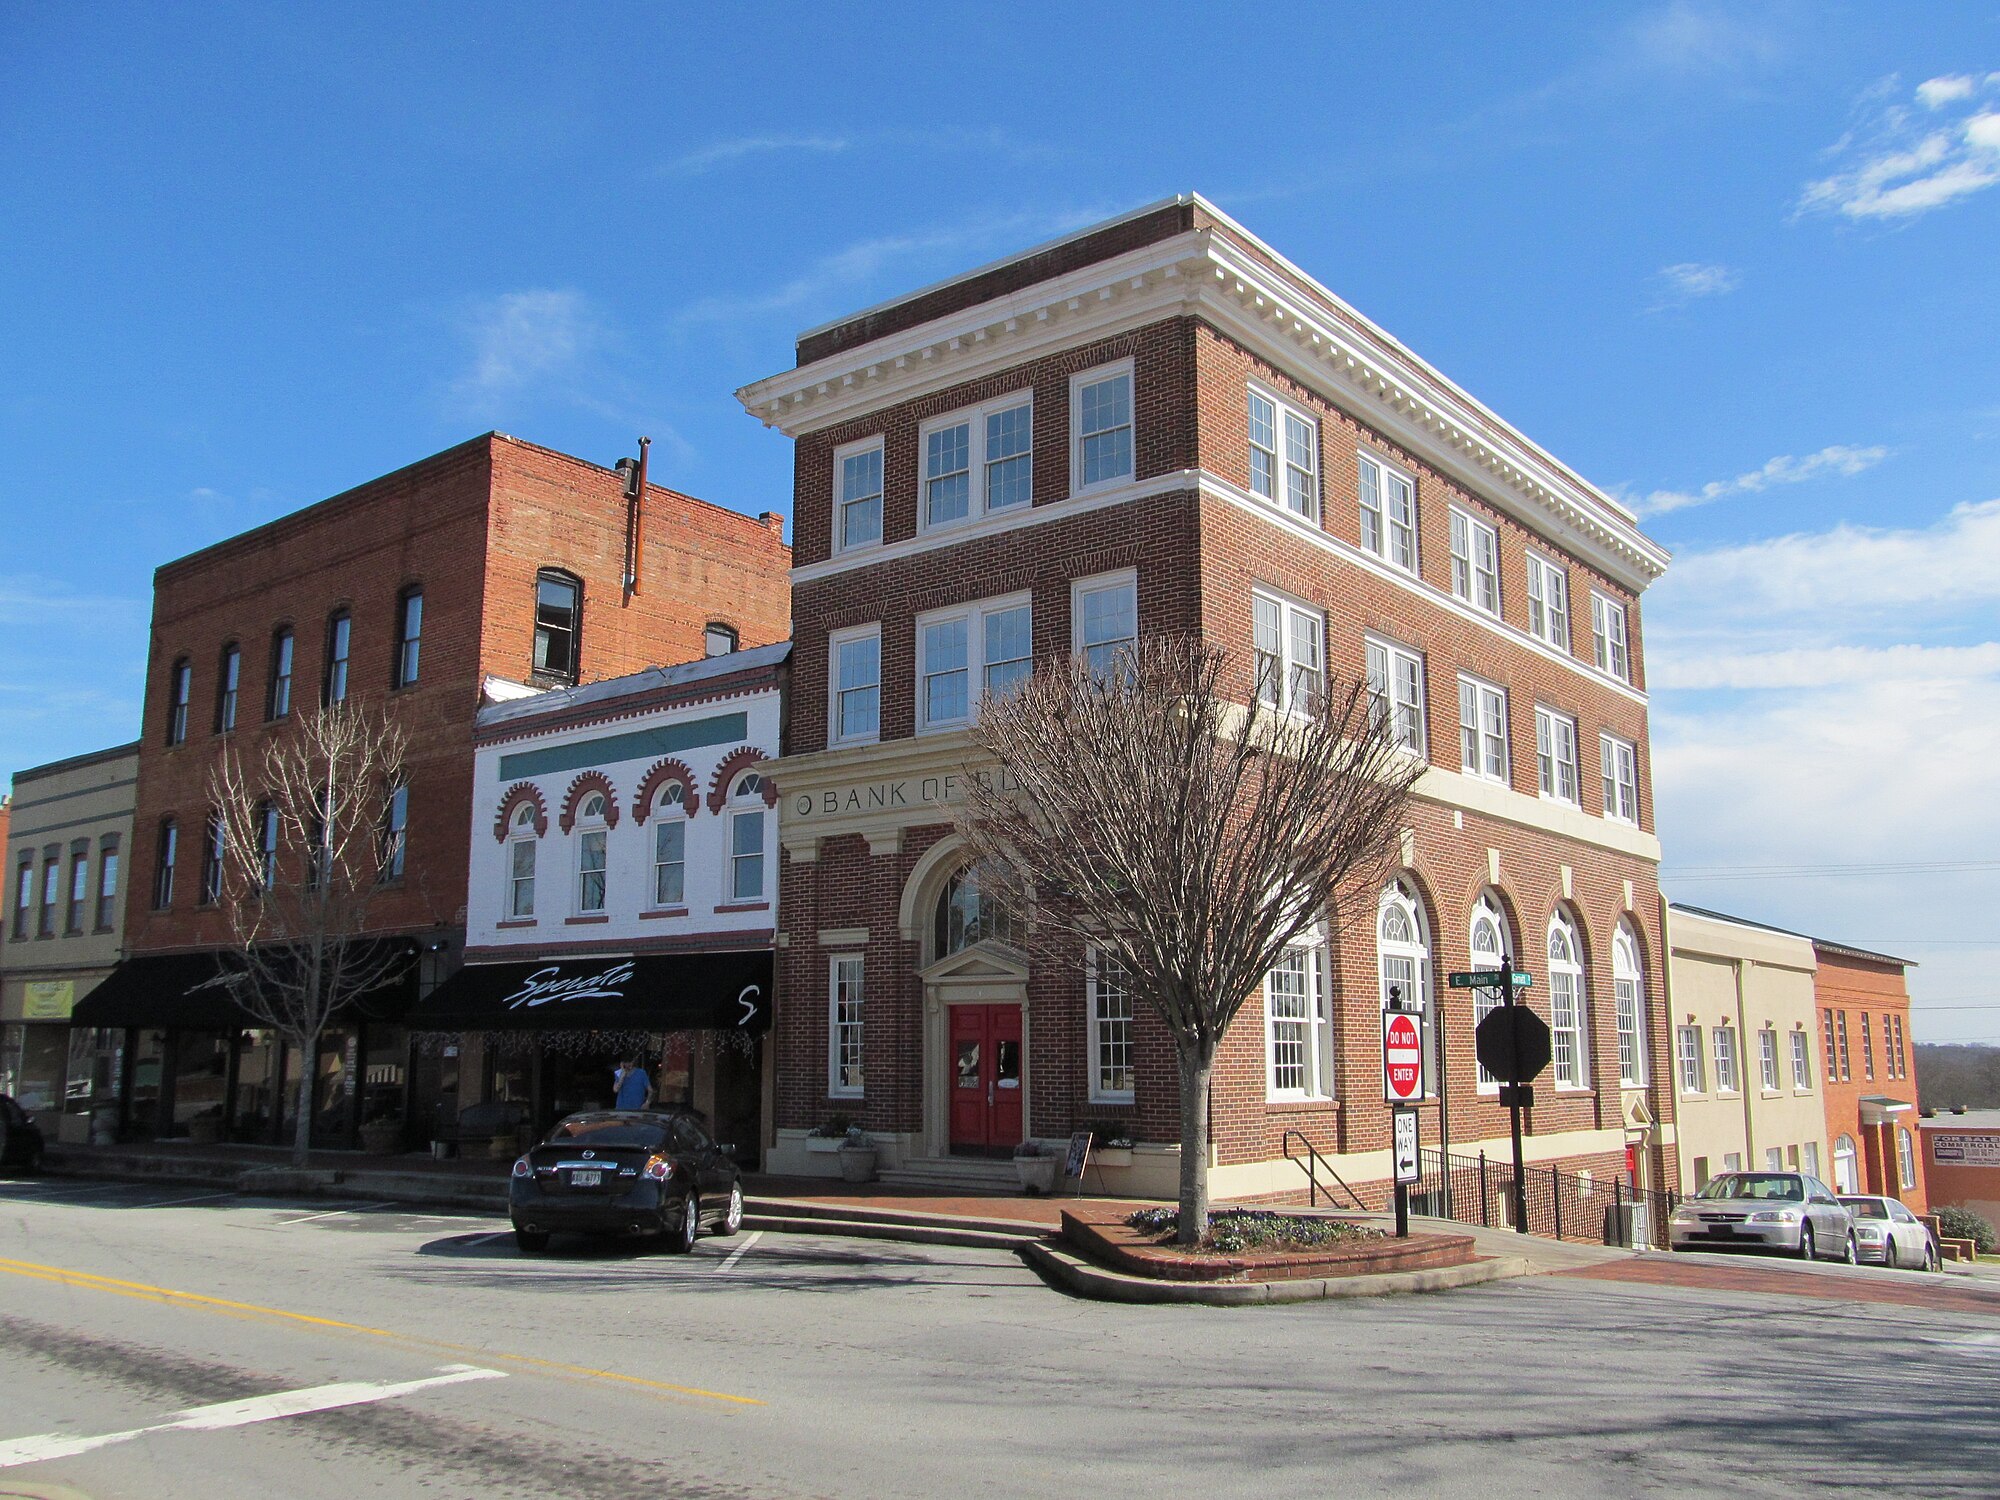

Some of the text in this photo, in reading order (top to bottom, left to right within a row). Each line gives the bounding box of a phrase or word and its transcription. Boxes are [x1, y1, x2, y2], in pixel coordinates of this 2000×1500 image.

[823, 782, 906, 813] BANK
[922, 775, 962, 801] OF
[1469, 975, 1488, 985] Main
[738, 985, 760, 1025] S
[1390, 1031, 1415, 1045] DO NOT
[1393, 1068, 1414, 1081] ENTER
[1397, 1118, 1413, 1134] ONE
[1397, 1136, 1414, 1153] WAY
